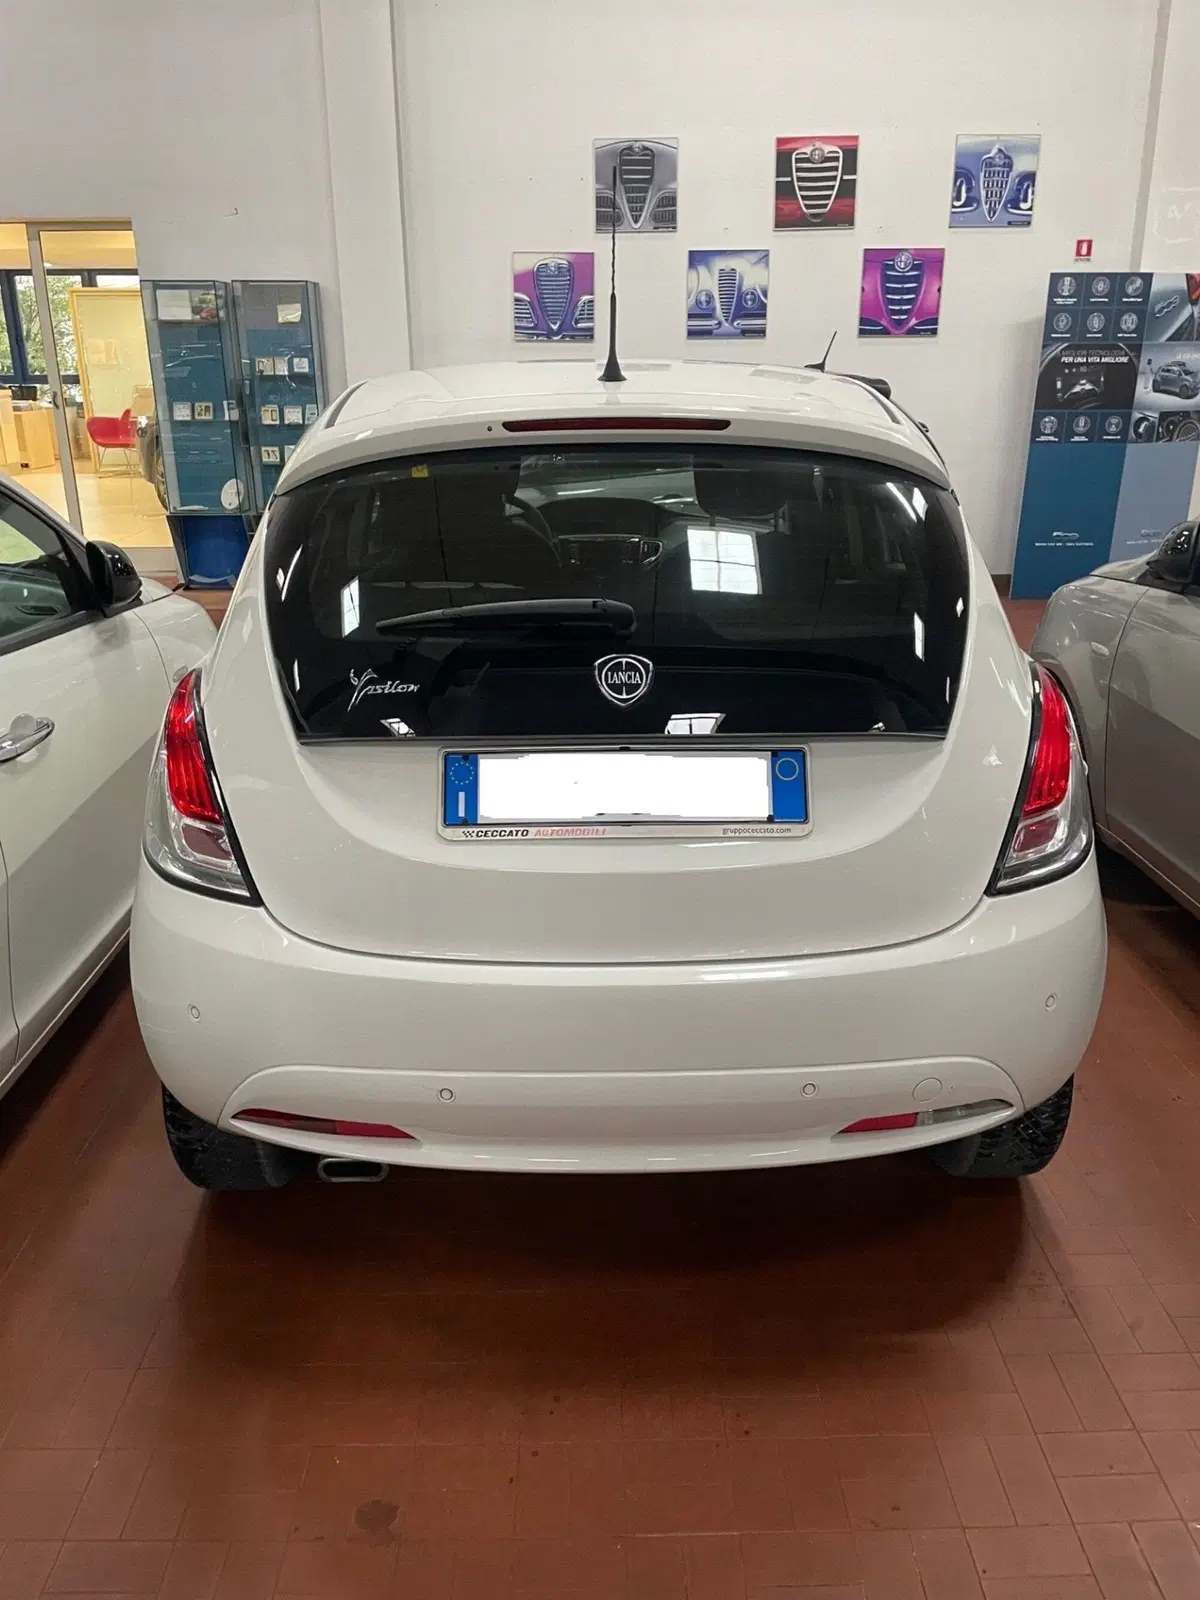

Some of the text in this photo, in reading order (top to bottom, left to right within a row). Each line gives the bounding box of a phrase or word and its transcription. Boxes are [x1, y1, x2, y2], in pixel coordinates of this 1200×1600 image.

[607, 671, 641, 684] LANCIA
[347, 668, 420, 712] Ypsilon
[475, 828, 607, 838] CECCATO AUTOMOBILI
[722, 827, 792, 836] gruppoceccato.com
